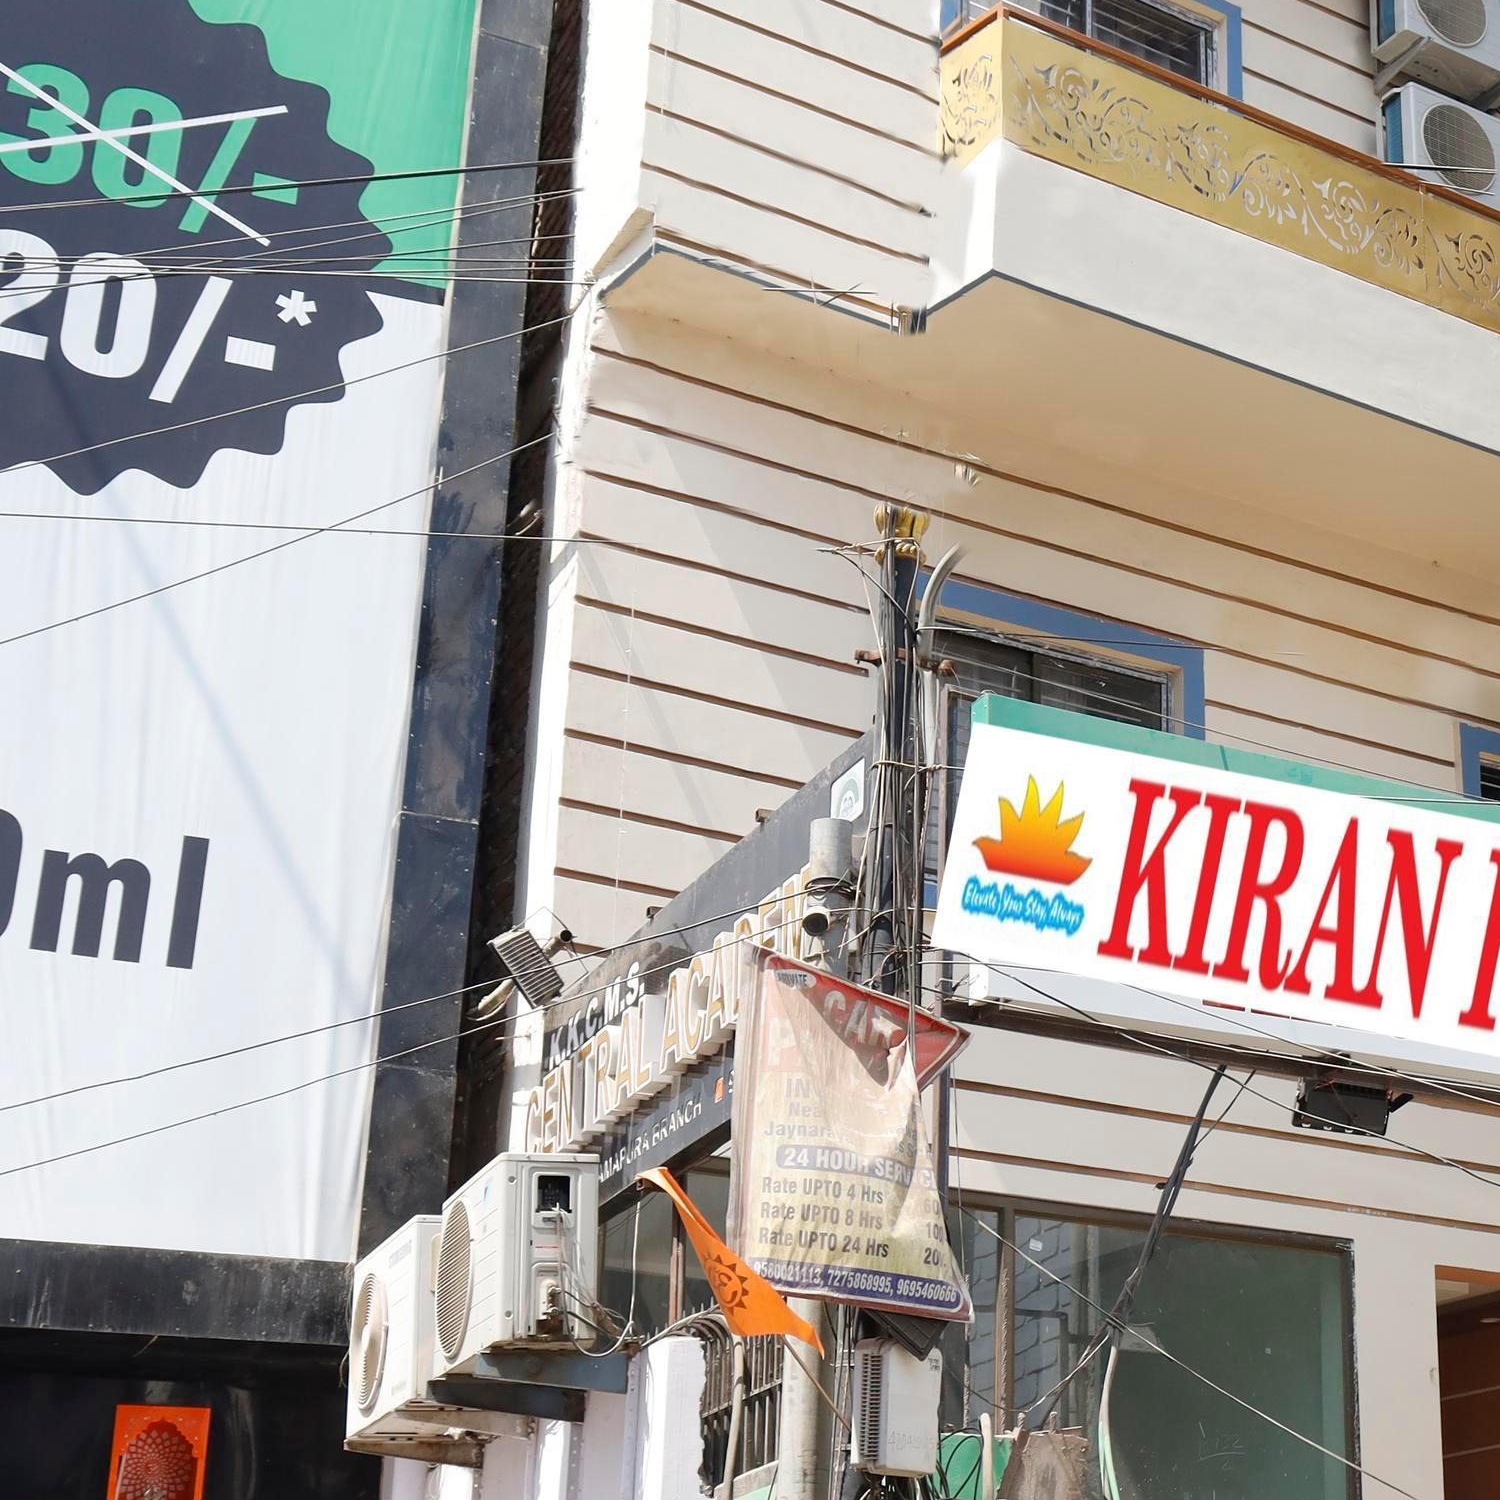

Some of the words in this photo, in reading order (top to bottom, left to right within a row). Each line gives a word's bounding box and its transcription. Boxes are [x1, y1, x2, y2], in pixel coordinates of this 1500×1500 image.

[0, 63, 300, 234] 30/-
[964, 881, 998, 911] Elevate
[1049, 899, 1081, 929] Always
[1098, 778, 1464, 1020] KIRAN
[526, 994, 653, 1153] CENTRAL
[659, 863, 811, 1077] ACADEM
[651, 1094, 703, 1148] BRANCH
[783, 1147, 809, 1167] 24
[815, 1149, 870, 1174] HOUR
[761, 1176, 797, 1195] Rate
[802, 1177, 842, 1199] UPTO
[846, 1184, 856, 1199] 4
[861, 1186, 884, 1205] Hrs
[760, 1202, 795, 1220] Rate
[801, 1203, 840, 1225] UPTO
[844, 1208, 854, 1226] 8
[859, 1210, 883, 1230] Hrs
[758, 1226, 793, 1247] Rate
[799, 1229, 837, 1252] UPTO
[842, 1233, 861, 1253] 24
[865, 1240, 890, 1258] Hrs
[827, 1268, 894, 1296] 7275868995,
